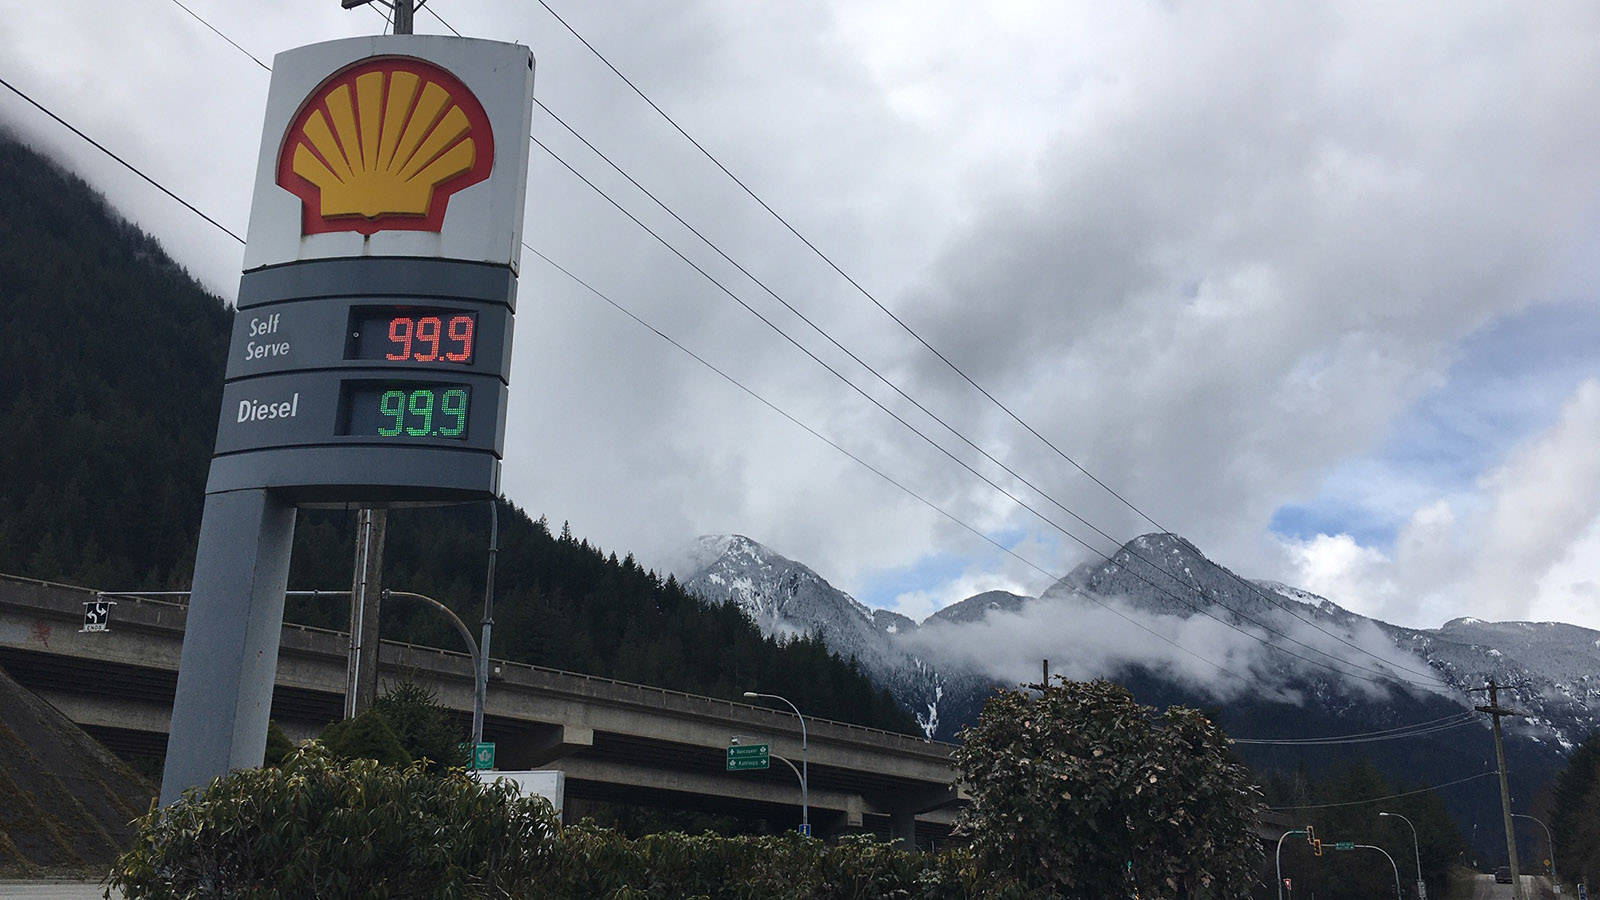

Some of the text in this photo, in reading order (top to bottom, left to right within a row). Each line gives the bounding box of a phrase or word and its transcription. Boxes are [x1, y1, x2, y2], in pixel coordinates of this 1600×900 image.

[249, 314, 280, 337] Self
[386, 316, 474, 361] 99.9
[245, 341, 290, 360] Serve
[237, 393, 299, 423] Diesel
[378, 390, 467, 437] 99.9
